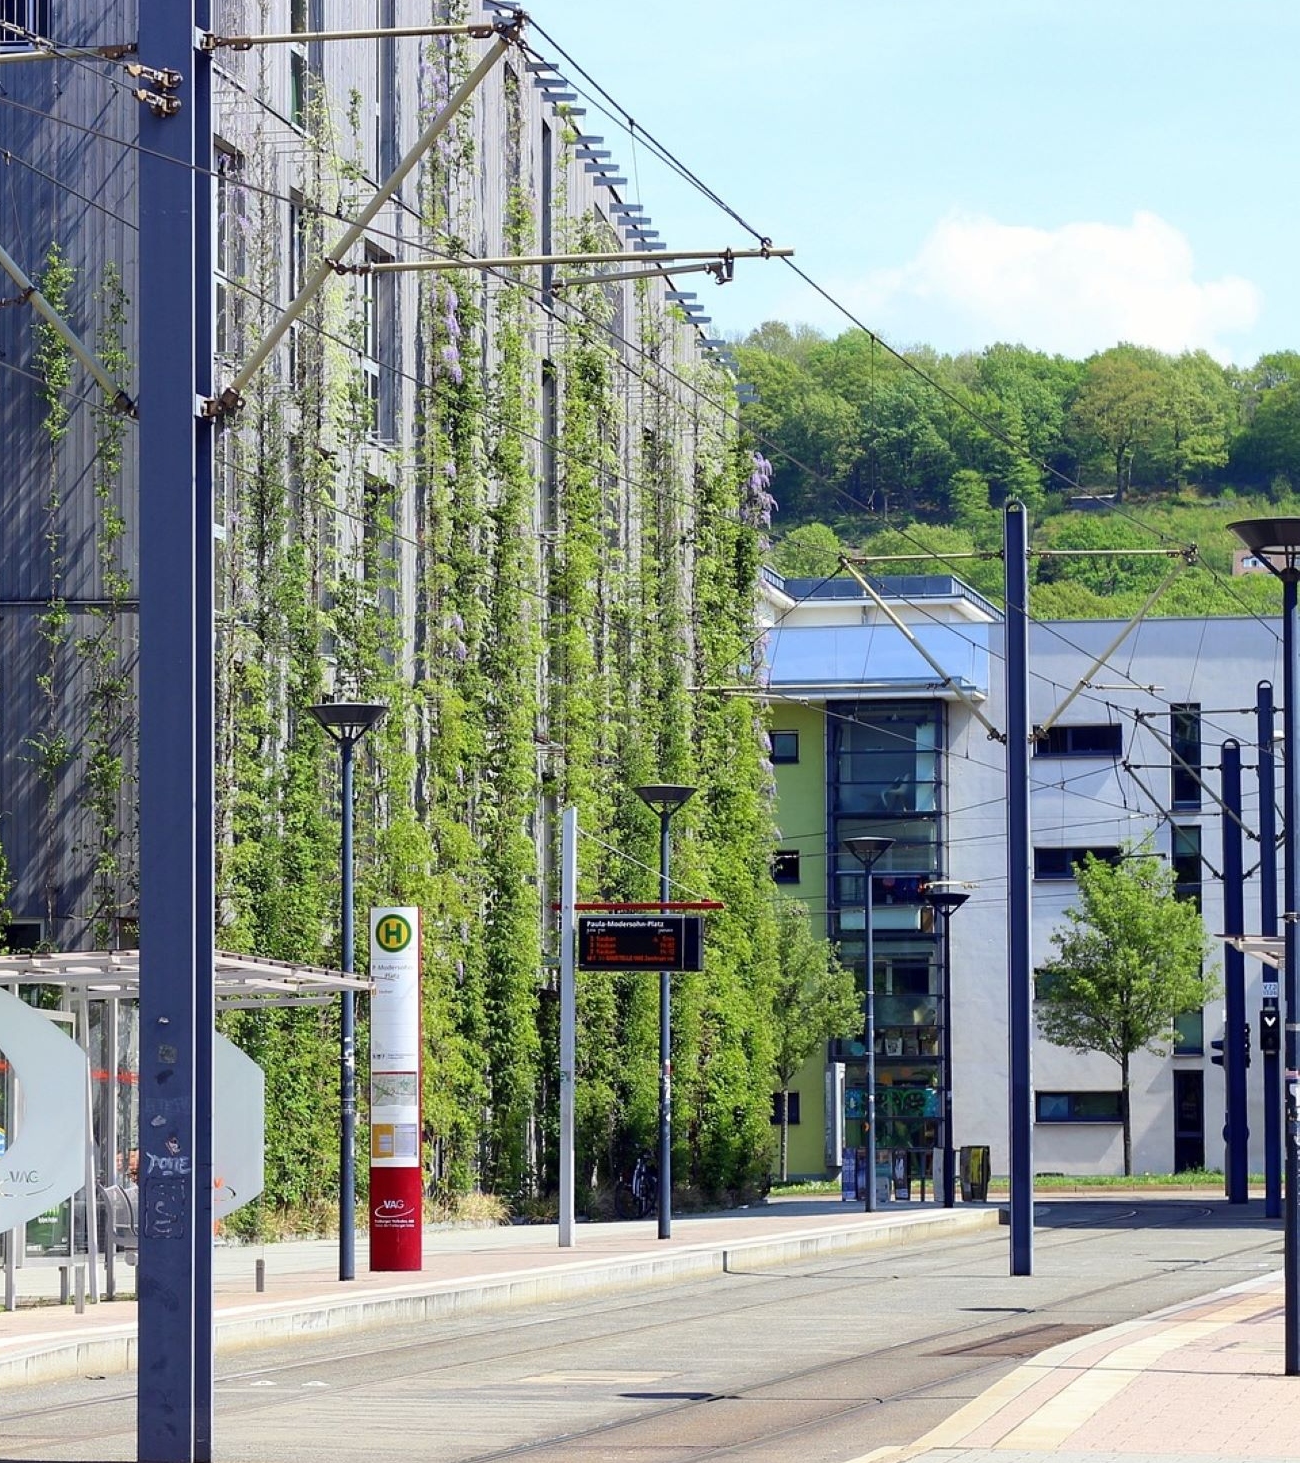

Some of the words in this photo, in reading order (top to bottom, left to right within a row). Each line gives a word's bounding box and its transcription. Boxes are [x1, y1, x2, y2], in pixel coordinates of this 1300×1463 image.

[586, 920, 664, 928] Paula-Modersohn-Platz
[385, 923, 402, 944] H
[9, 1170, 40, 1183] VAG
[383, 1199, 404, 1209] VAG
